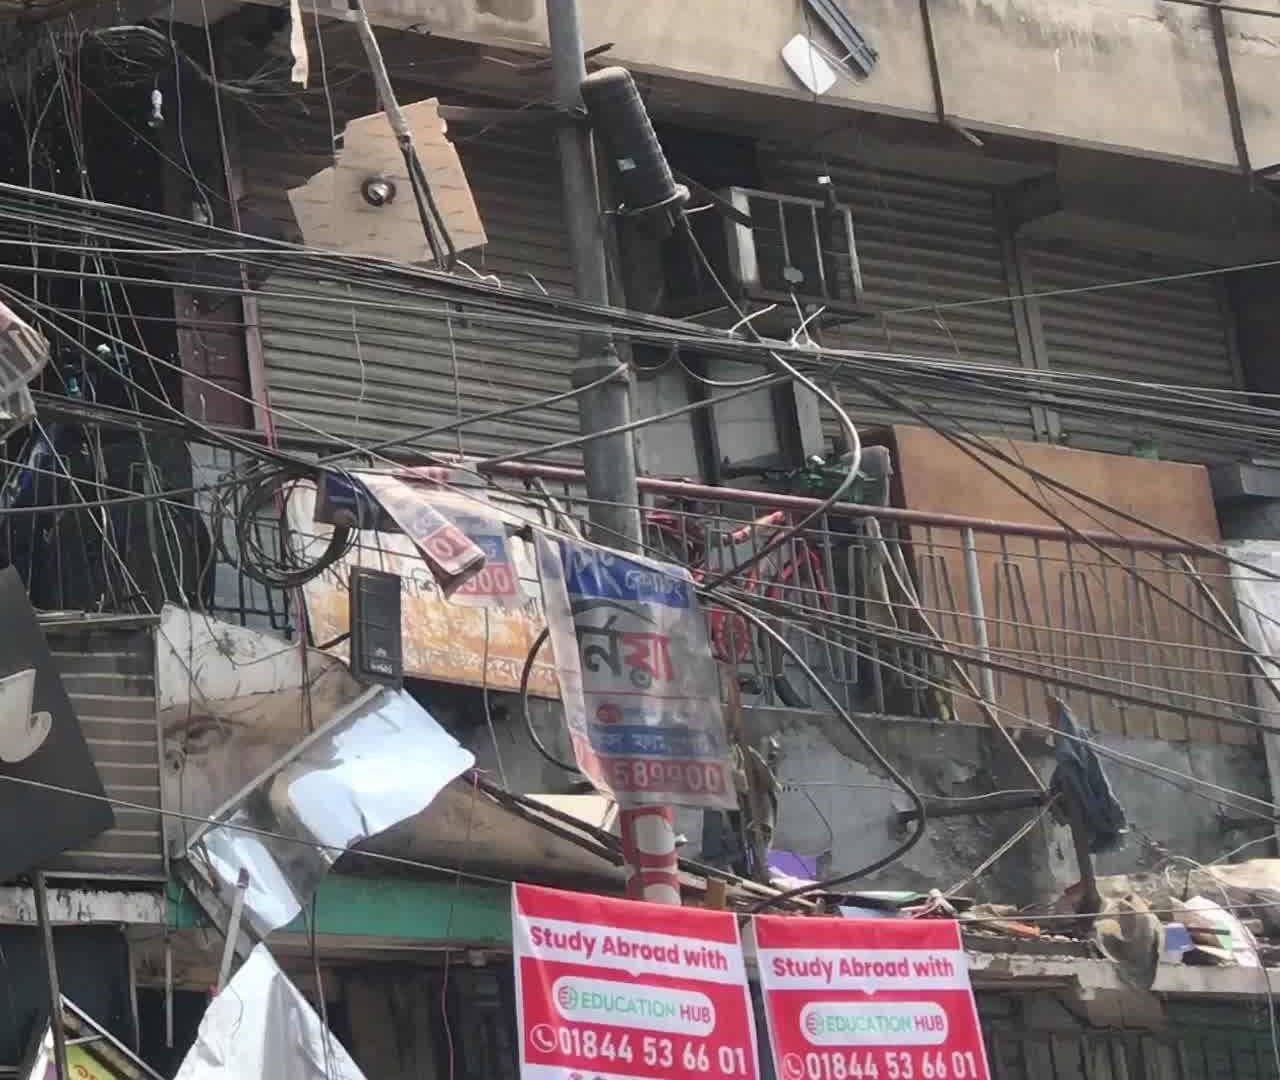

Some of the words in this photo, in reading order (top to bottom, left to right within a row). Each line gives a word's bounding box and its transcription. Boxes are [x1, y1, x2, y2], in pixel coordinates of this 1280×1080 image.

[531, 926, 597, 957] Study
[601, 934, 679, 963] Abroad
[684, 947, 729, 970] with
[773, 958, 834, 983] Study
[839, 956, 909, 979] Abroad
[913, 956, 954, 977] with
[581, 992, 676, 1017] EDUCATION
[680, 1004, 711, 1023] HUB
[826, 1014, 912, 1033] EDUCATION
[914, 1014, 944, 1032] HUB
[558, 1027, 634, 1063] 01844
[643, 1038, 674, 1069] 53
[683, 1044, 710, 1072] 66
[718, 1048, 747, 1077] 01
[805, 1052, 878, 1080] 01844
[888, 1053, 913, 1080] 53
[921, 1051, 948, 1078] 66
[952, 1050, 977, 1077] 01
